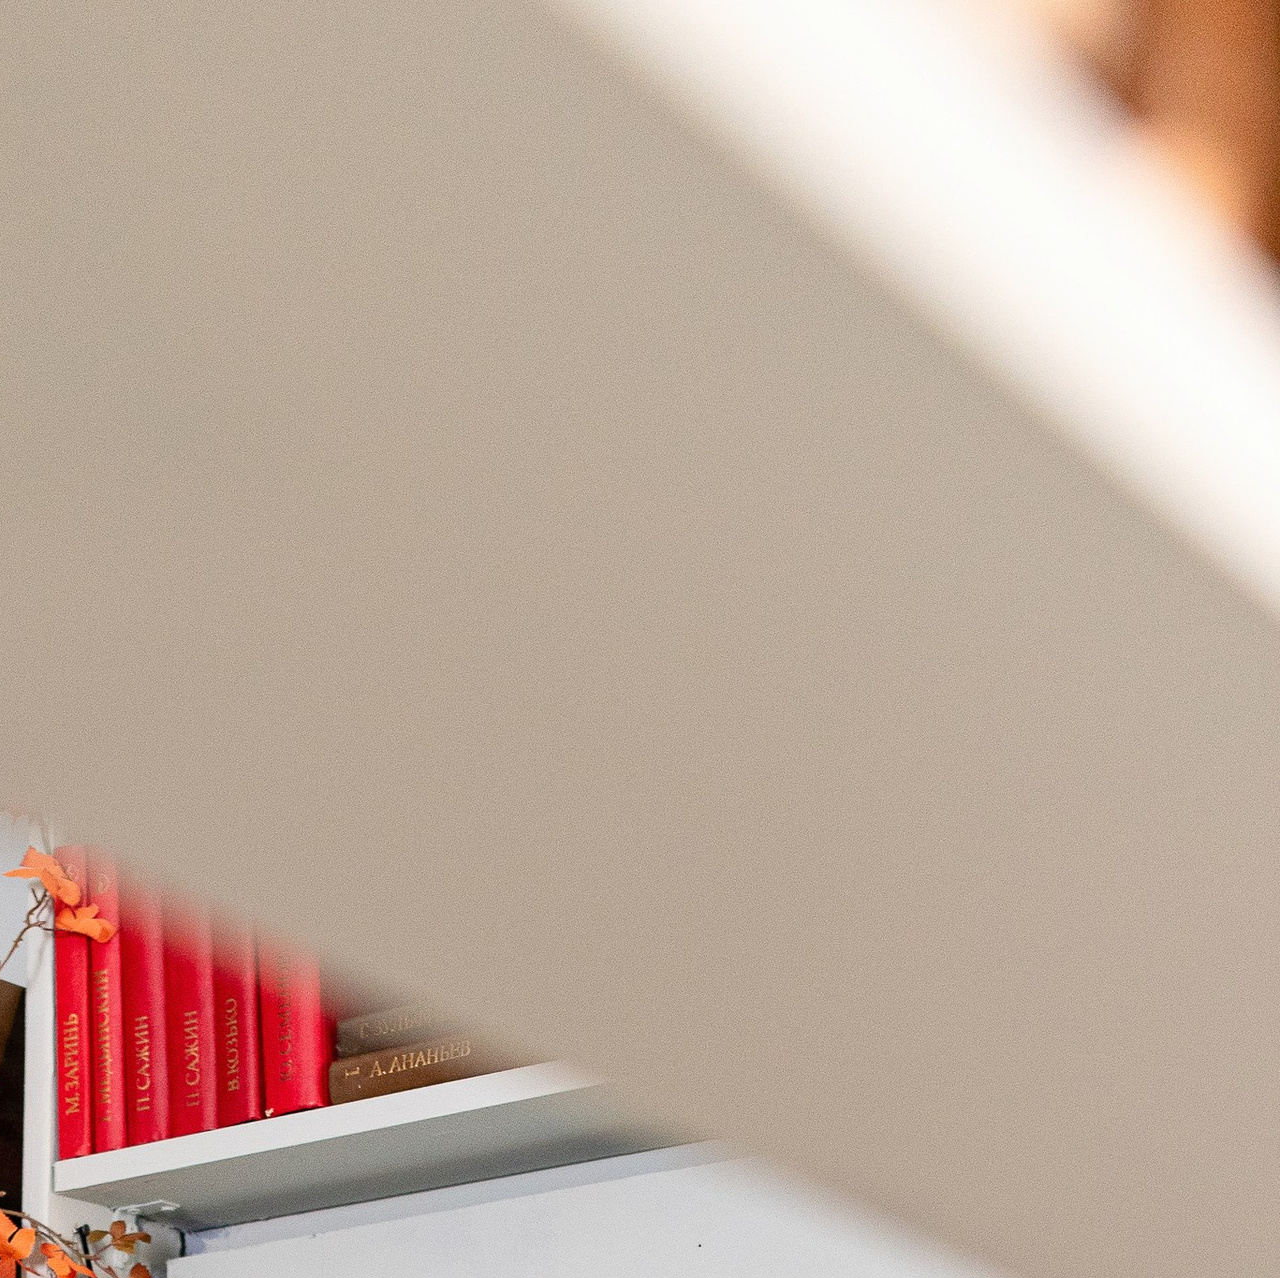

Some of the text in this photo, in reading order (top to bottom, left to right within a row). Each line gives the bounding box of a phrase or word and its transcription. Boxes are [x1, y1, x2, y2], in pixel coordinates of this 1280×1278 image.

[63, 1012, 81, 1116] М. ЗАРИНЬ
[135, 1016, 150, 1092] САЖИН
[184, 1010, 200, 1086] САЖИН
[225, 998, 240, 1092] В. КОЗЬКО
[370, 1060, 387, 1078] А.
[388, 1040, 471, 1074] АНАНЬЕВ
